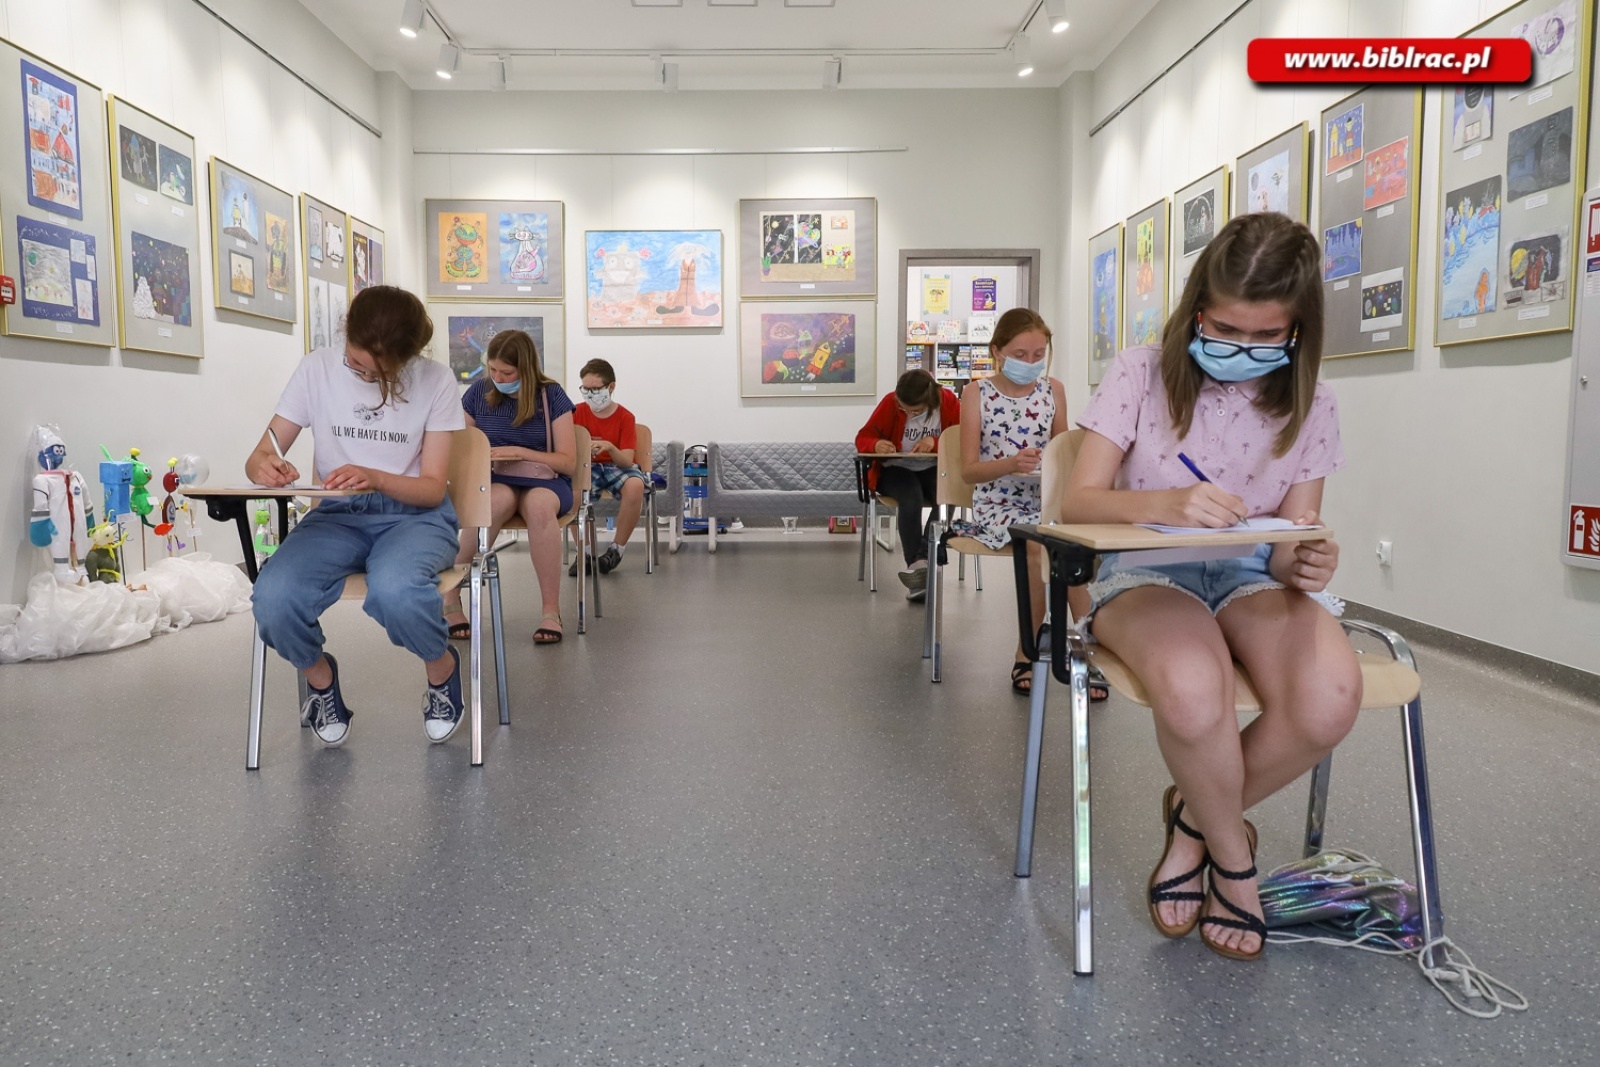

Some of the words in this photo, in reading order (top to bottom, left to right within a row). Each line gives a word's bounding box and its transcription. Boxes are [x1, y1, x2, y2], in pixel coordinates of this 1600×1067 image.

[344, 426, 355, 438] WE
[357, 428, 378, 440] HAVE
[380, 430, 387, 441] IS
[388, 431, 409, 443] NOW.
[904, 428, 921, 441] arry
